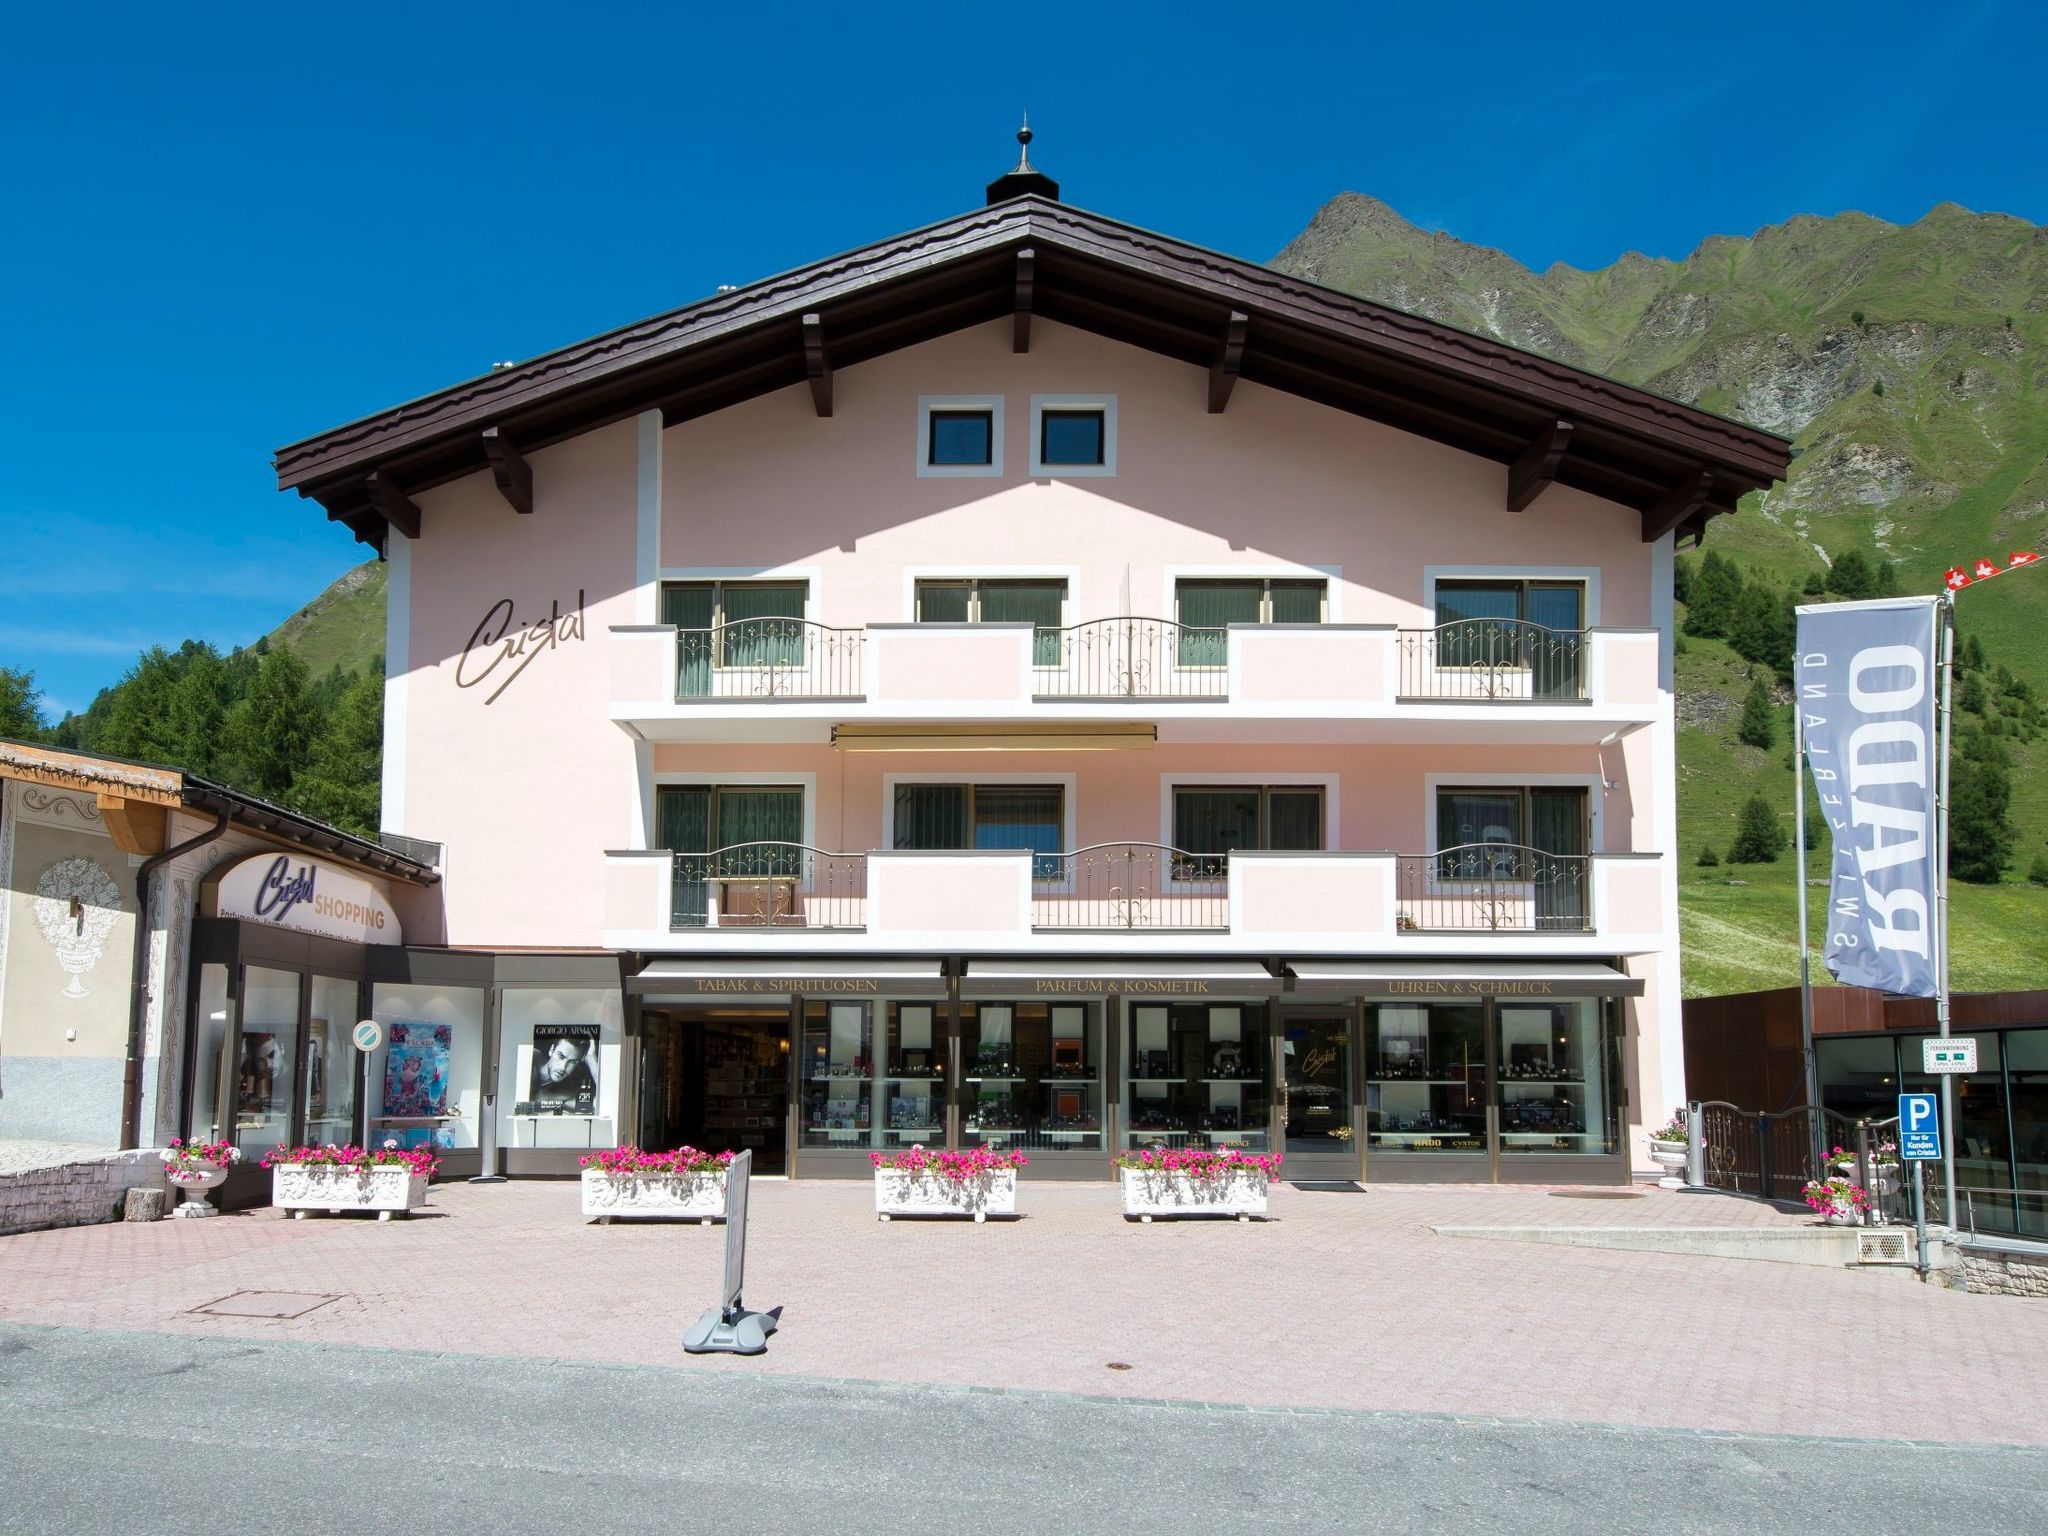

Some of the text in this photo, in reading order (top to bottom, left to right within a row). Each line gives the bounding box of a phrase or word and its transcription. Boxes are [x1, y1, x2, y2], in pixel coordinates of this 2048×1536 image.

[456, 589, 585, 705] Cristal
[314, 893, 385, 930] SHOPPING
[695, 979, 878, 992] TABAK & SPIRITUOSEN
[1036, 980, 1208, 993] PARFUM & KOSMETIK
[1388, 981, 1553, 994] UHREN & SCHMUCK
[536, 1026, 598, 1035] GIORGIO ARMANI
[1910, 1099, 1930, 1131] P
[1414, 1139, 1442, 1147] RADO
[1907, 1141, 1934, 1149] Kunden
